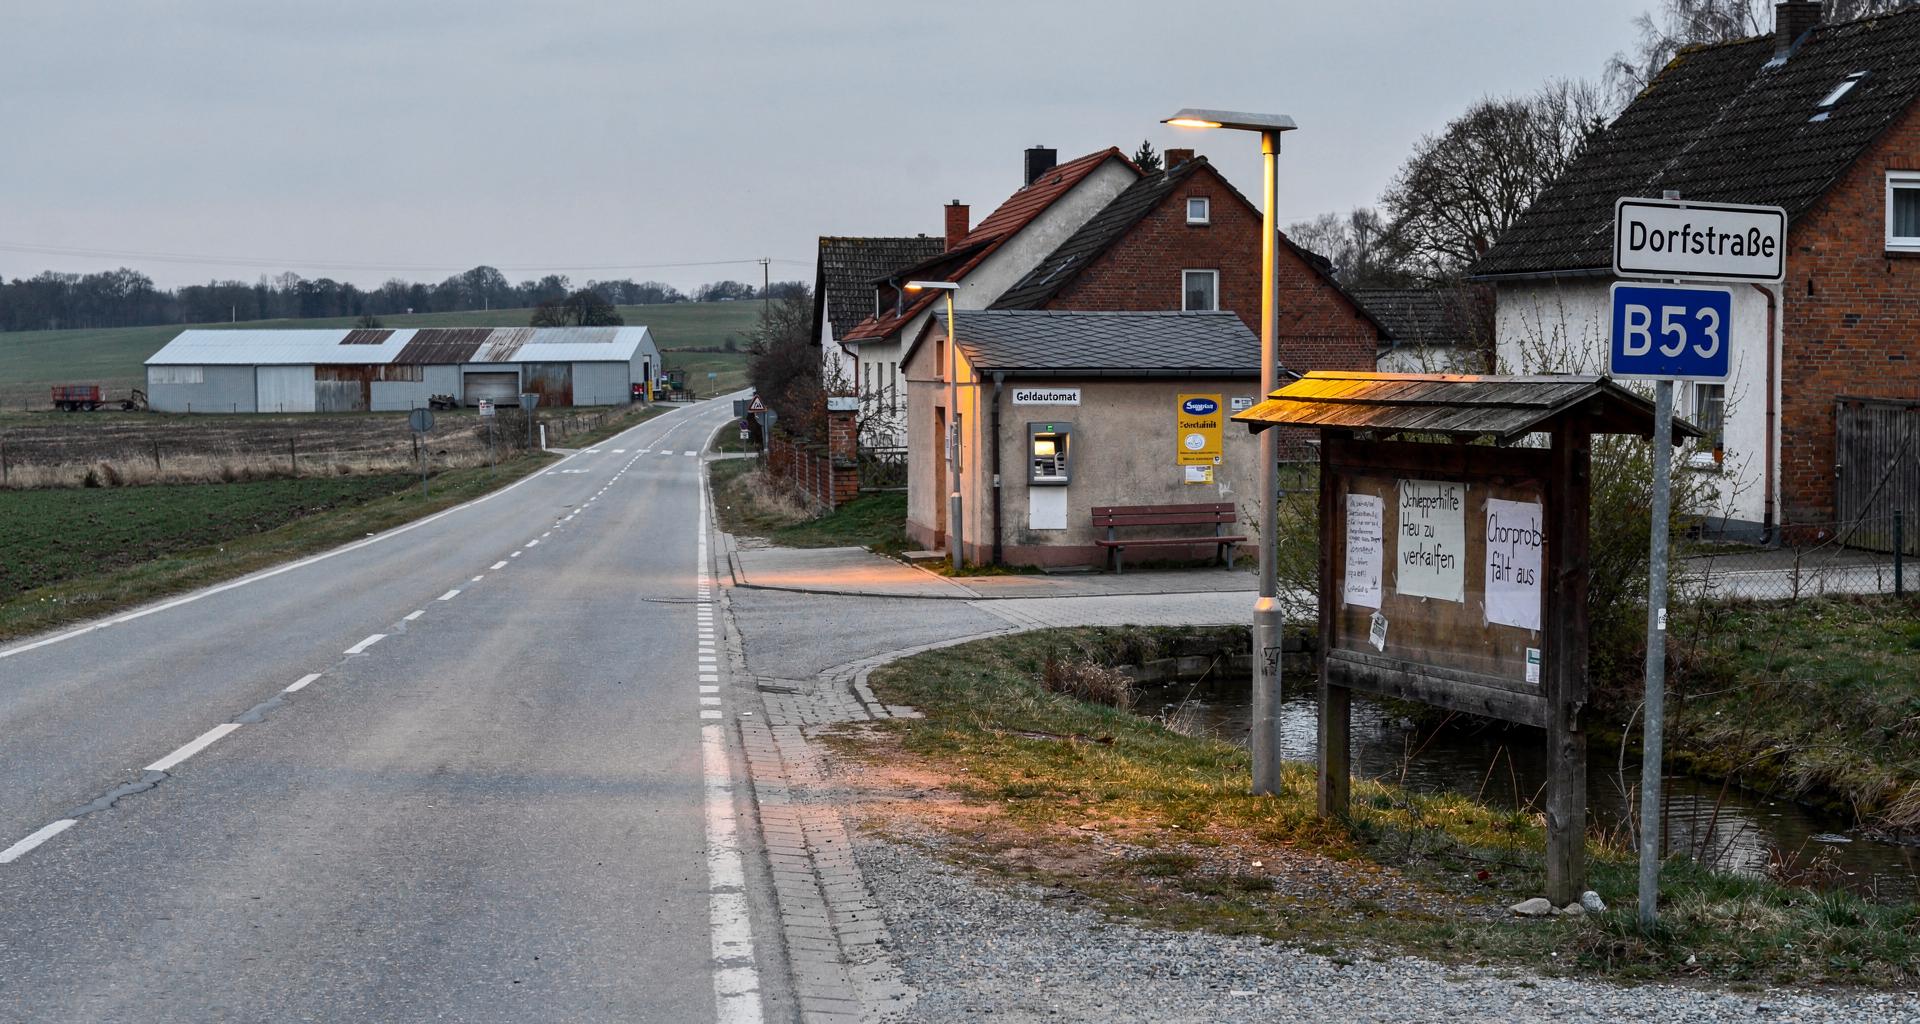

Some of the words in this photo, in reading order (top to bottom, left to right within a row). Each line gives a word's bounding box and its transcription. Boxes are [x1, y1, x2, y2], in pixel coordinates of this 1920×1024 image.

[1630, 220, 1775, 258] Dorfstraße
[1623, 303, 1720, 359] B53
[1016, 391, 1077, 402] Geldautomat
[1402, 511, 1420, 537] Heu
[1424, 524, 1435, 538] zu
[1516, 567, 1535, 586] aus
